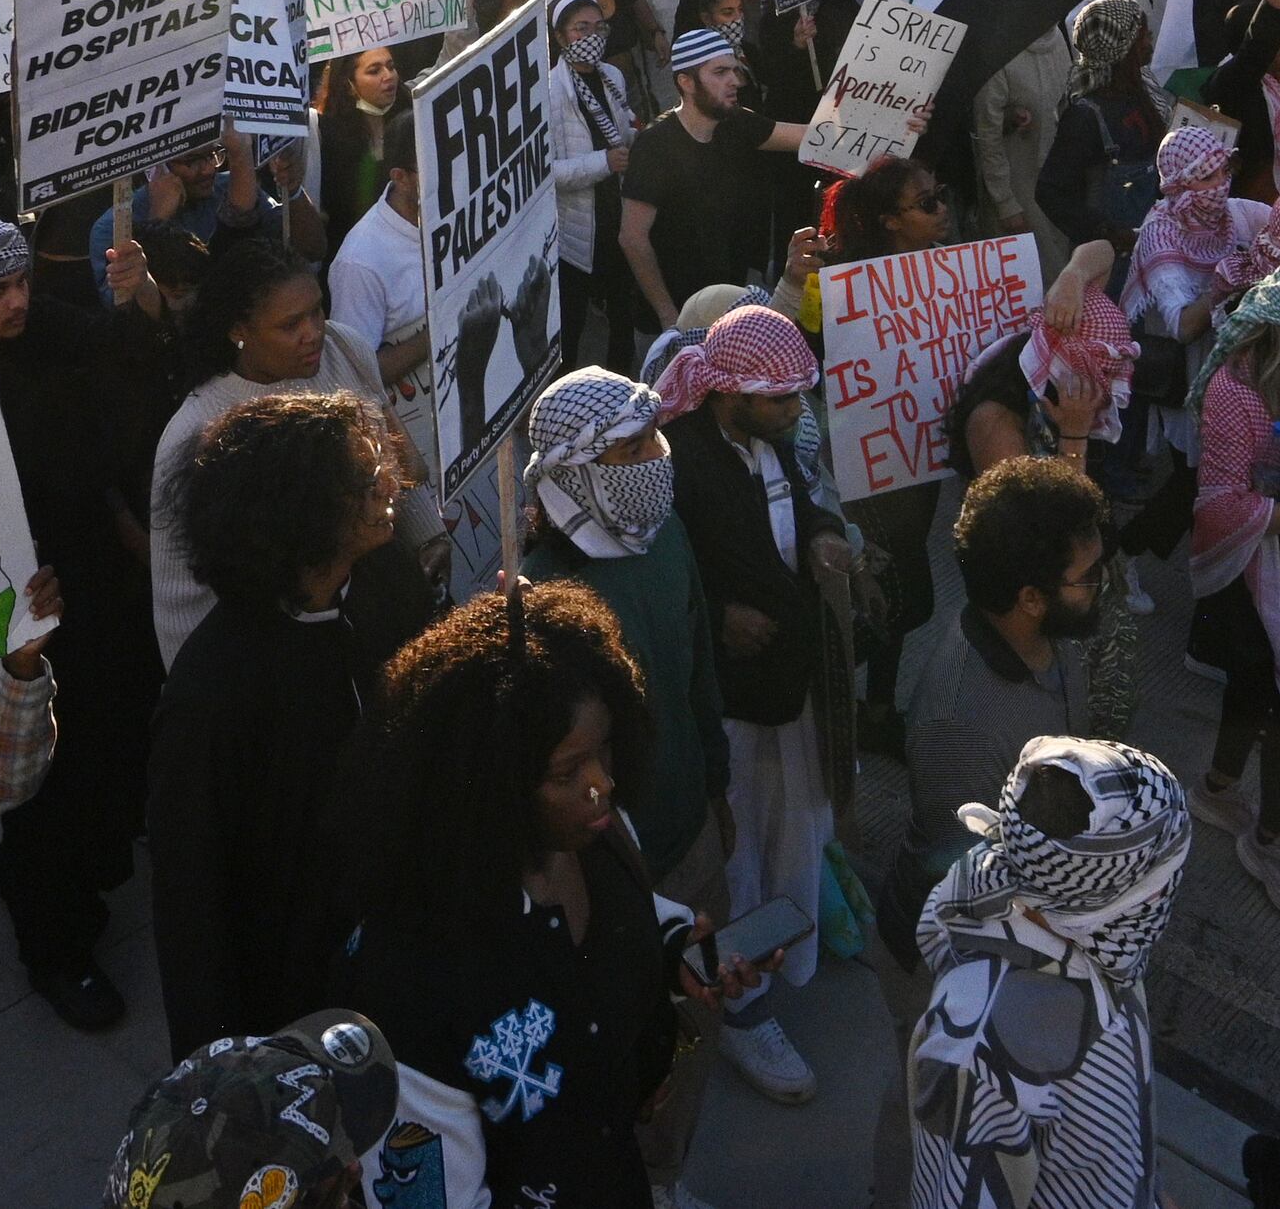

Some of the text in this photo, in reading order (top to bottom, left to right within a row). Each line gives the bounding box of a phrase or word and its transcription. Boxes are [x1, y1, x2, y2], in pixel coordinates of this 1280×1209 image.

[335, 8, 400, 51] FREE
[854, 35, 926, 77] is an
[27, 52, 223, 142] BIDEN PAYS
[822, 63, 935, 114] Apartheid
[74, 97, 180, 156] FOR IT
[432, 20, 543, 220] FREE
[808, 121, 905, 161] STATE
[60, 120, 215, 185] PARTY FOR SOCIALISM LIBERATION
[432, 124, 550, 290] PALESTINE
[830, 237, 1020, 325] INJUSTICE
[873, 279, 1027, 351] ANYWHERE
[826, 358, 878, 410] IS
[895, 349, 919, 387] A
[871, 390, 919, 435] TO
